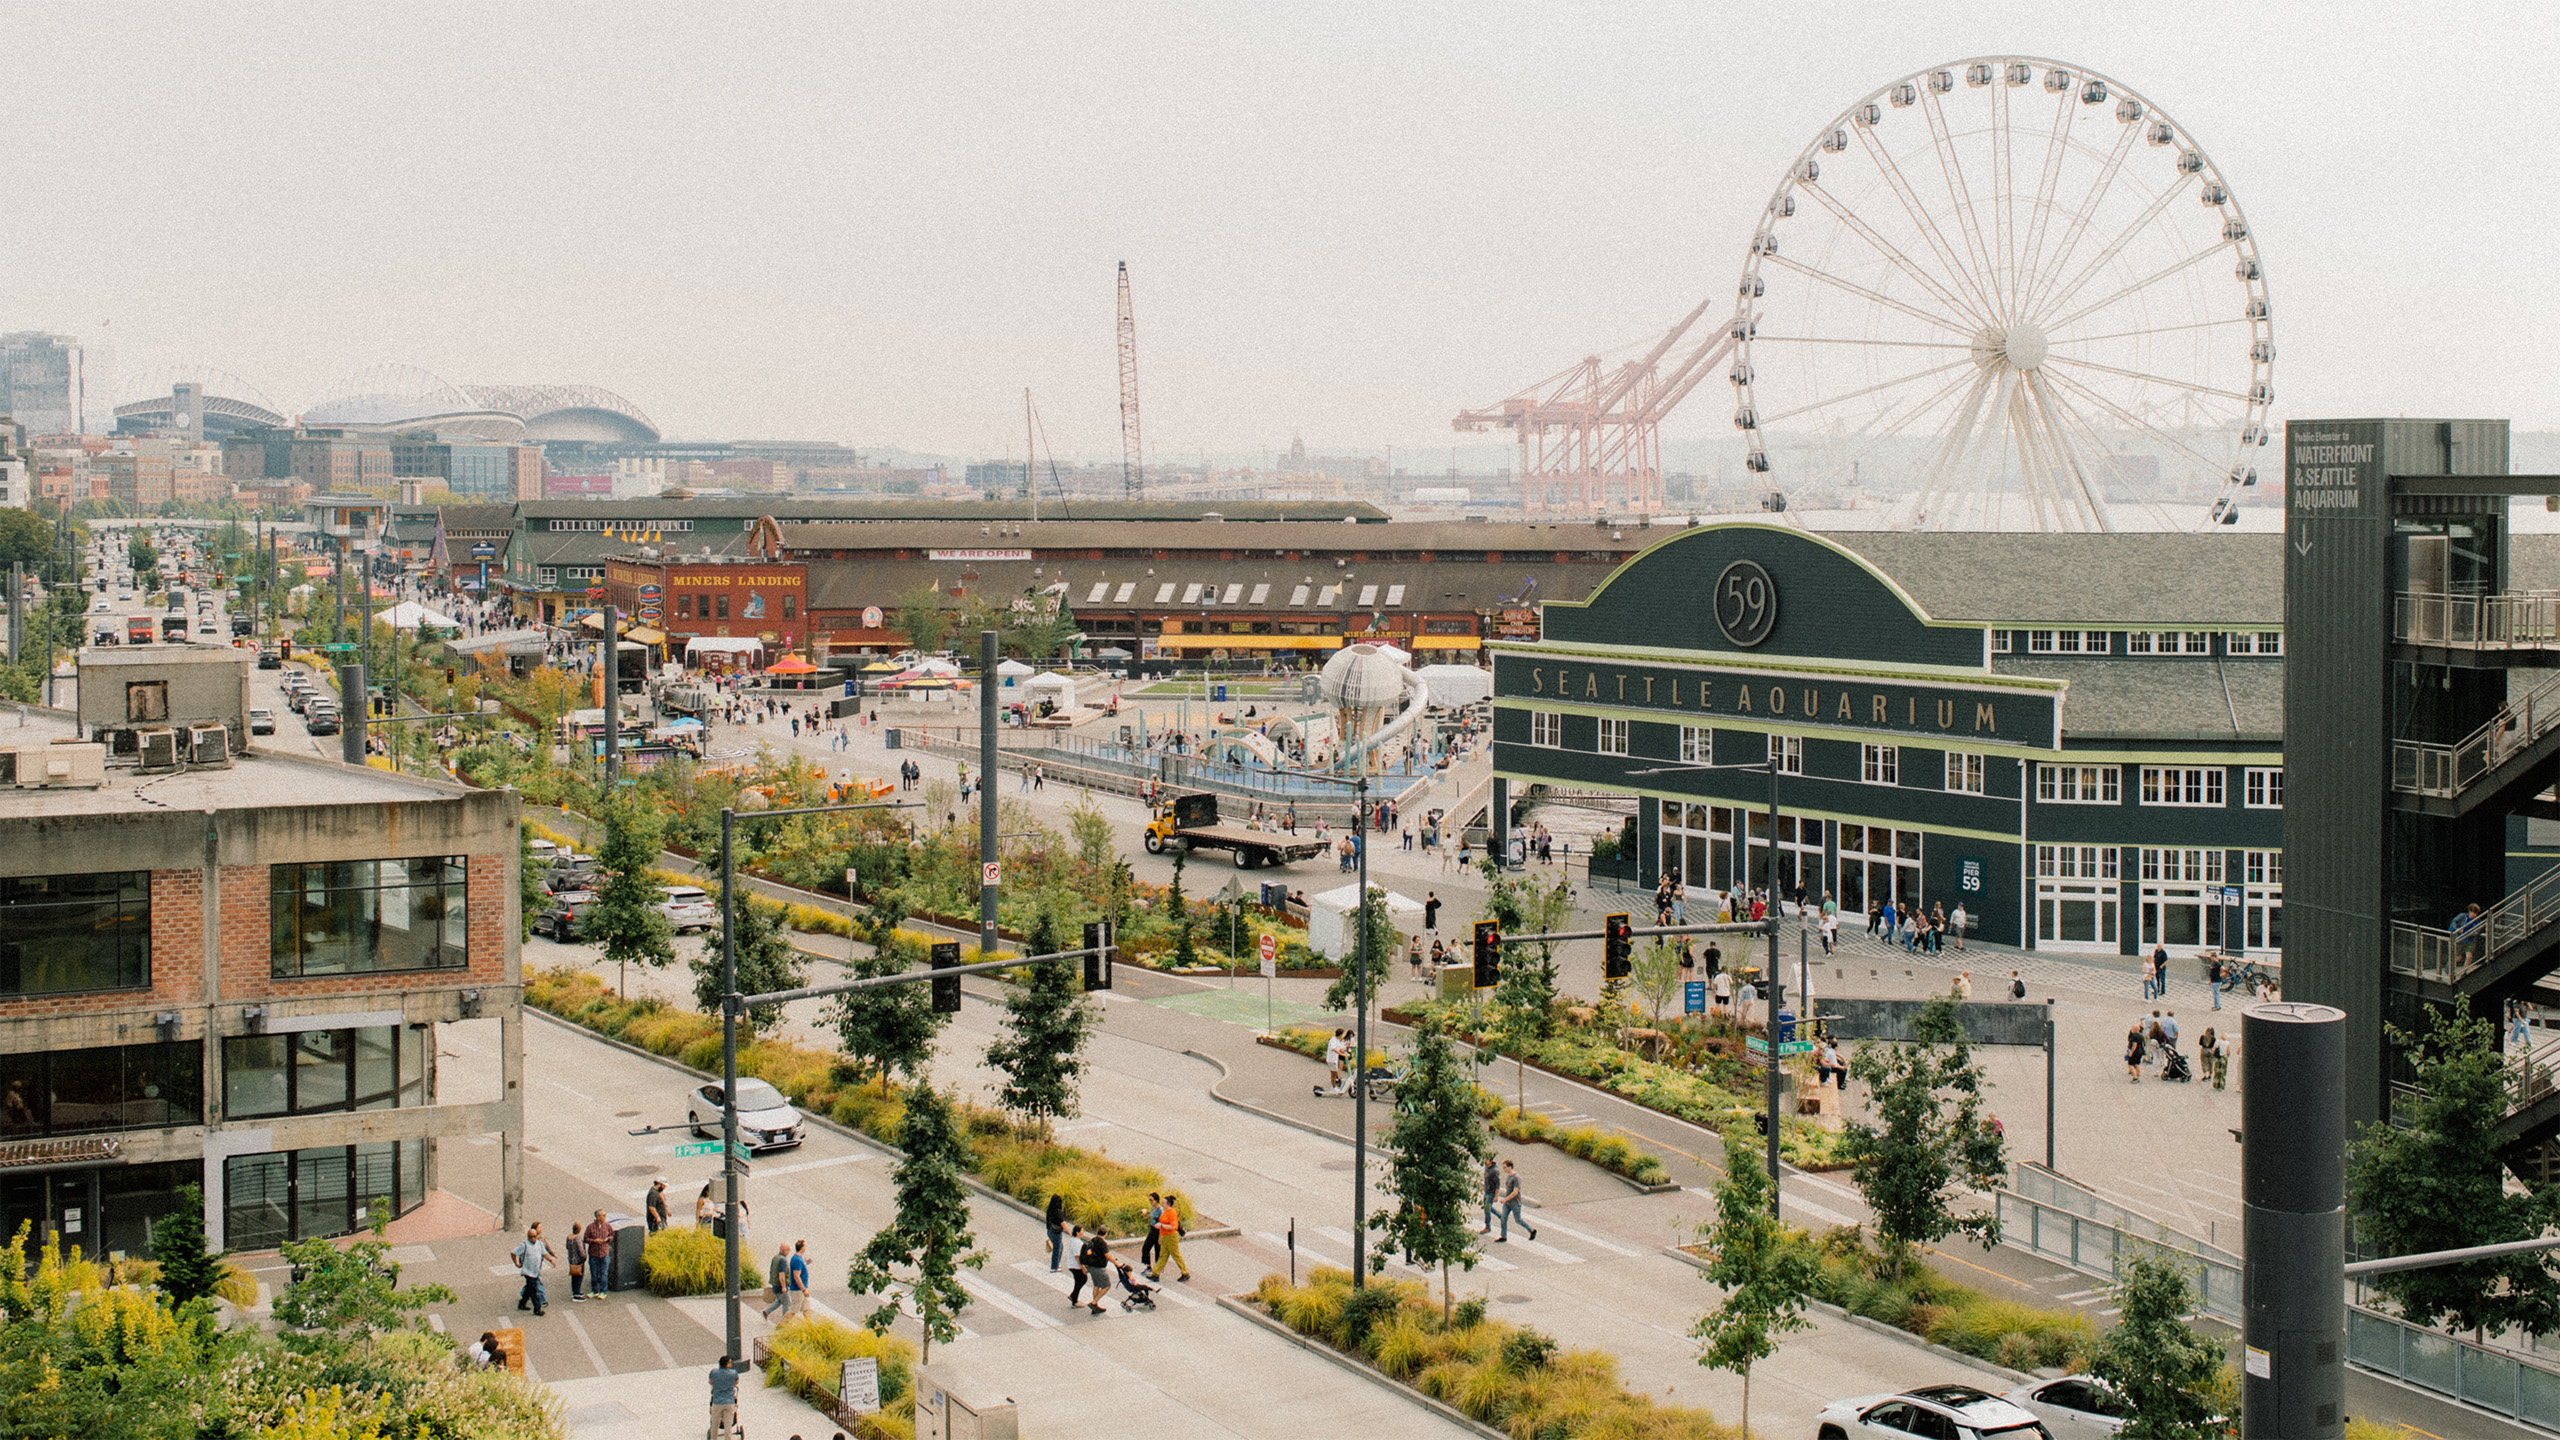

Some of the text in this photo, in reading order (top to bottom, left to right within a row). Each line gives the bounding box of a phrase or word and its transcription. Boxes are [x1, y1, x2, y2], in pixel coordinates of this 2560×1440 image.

[2295, 432, 2314, 442] Public
[2295, 444, 2374, 464] WATERFRONT
[2295, 468, 2356, 486] & SEATTLE
[2295, 490, 2360, 510] AQUARIUM
[673, 576, 801, 586] MINERS LANDING
[1728, 576, 1766, 631] 59
[1533, 667, 1996, 733] SEATTLE AQUARIUM
[1964, 868, 1980, 876] PIER
[1962, 876, 1980, 891] 59
[1786, 1044, 1798, 1053] Pike
[684, 1146, 701, 1156] Pike
